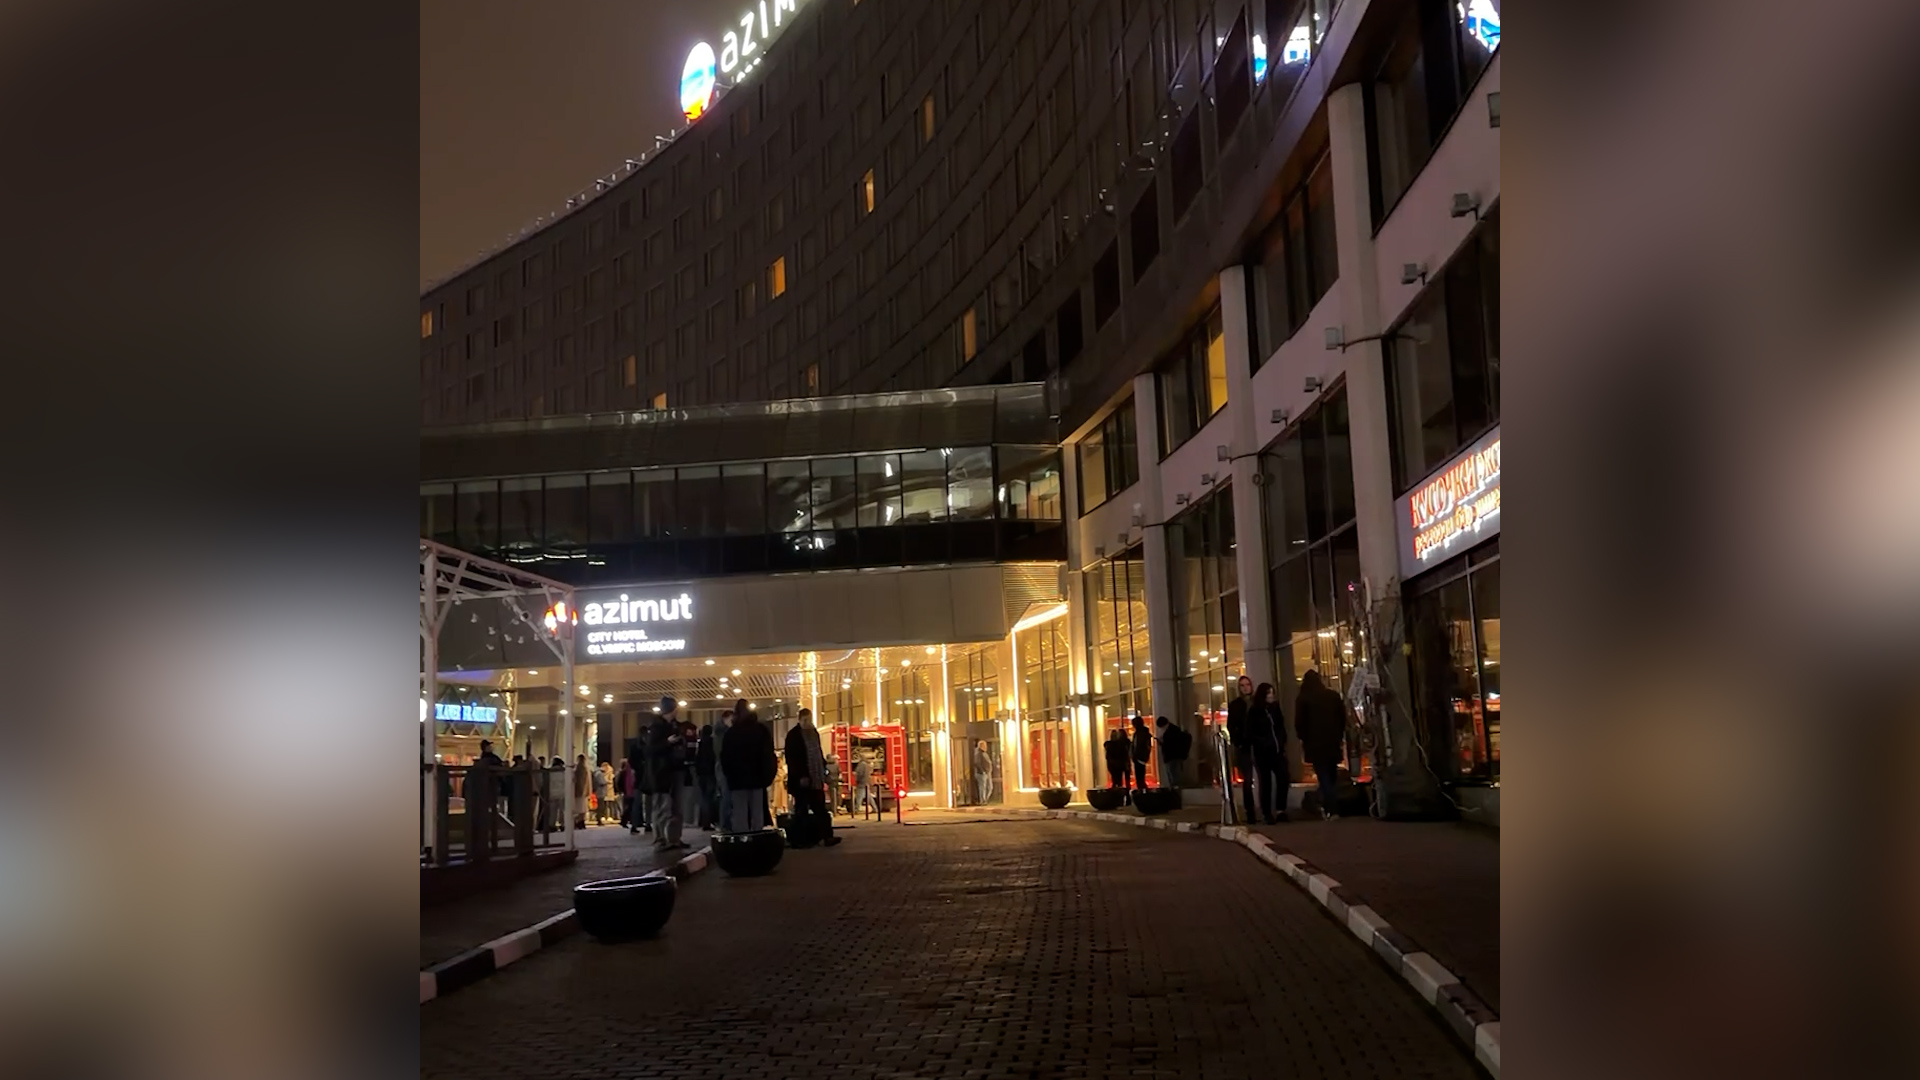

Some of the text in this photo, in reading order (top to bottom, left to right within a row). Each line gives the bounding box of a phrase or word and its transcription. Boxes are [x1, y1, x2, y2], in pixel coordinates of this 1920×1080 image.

[584, 593, 693, 625] azimut
[587, 629, 648, 643] CITY HOTEL
[636, 639, 686, 652] MOSCOW
